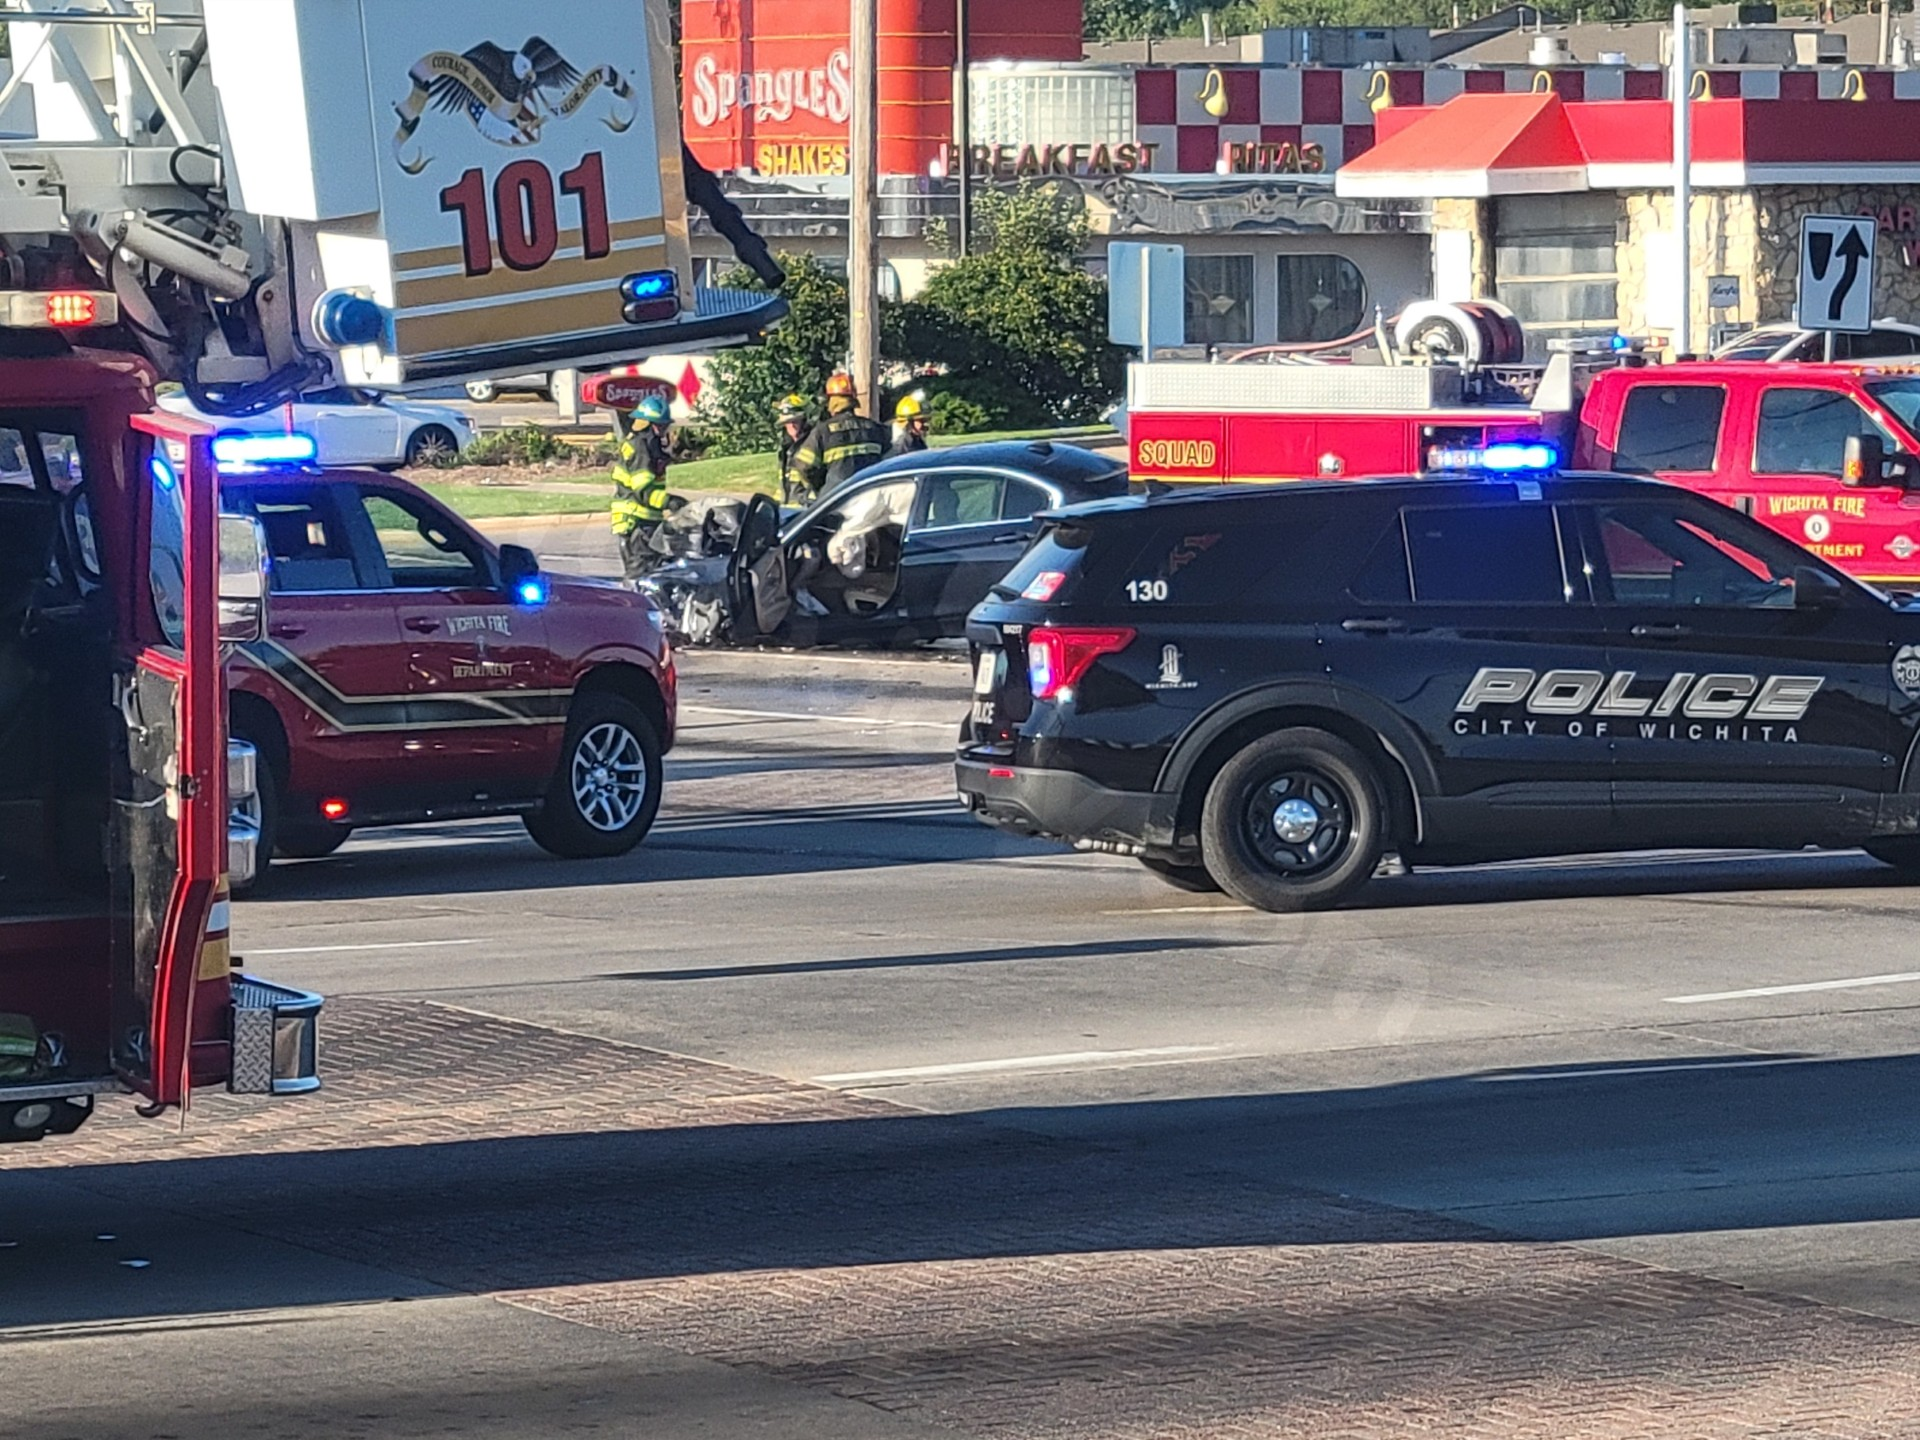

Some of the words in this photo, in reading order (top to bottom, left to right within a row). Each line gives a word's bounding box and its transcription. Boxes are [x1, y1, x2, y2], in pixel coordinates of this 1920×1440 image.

[758, 144, 846, 177] SHAKES
[940, 142, 1160, 176] BREAKFAST
[438, 150, 611, 277] 101
[1138, 439, 1216, 469] SQUAD
[1769, 496, 1829, 516] WICHITA
[1833, 496, 1866, 518] FIRE
[1125, 580, 1168, 602] 130
[446, 615, 486, 637] WICHITA
[487, 614, 512, 637] FIRE
[453, 663, 513, 678] DEPARTMENT
[1454, 667, 1826, 721] POLICE
[1454, 719, 1537, 736] CITY
[1568, 721, 1608, 738] OF
[1639, 723, 1798, 742] WICHITA
